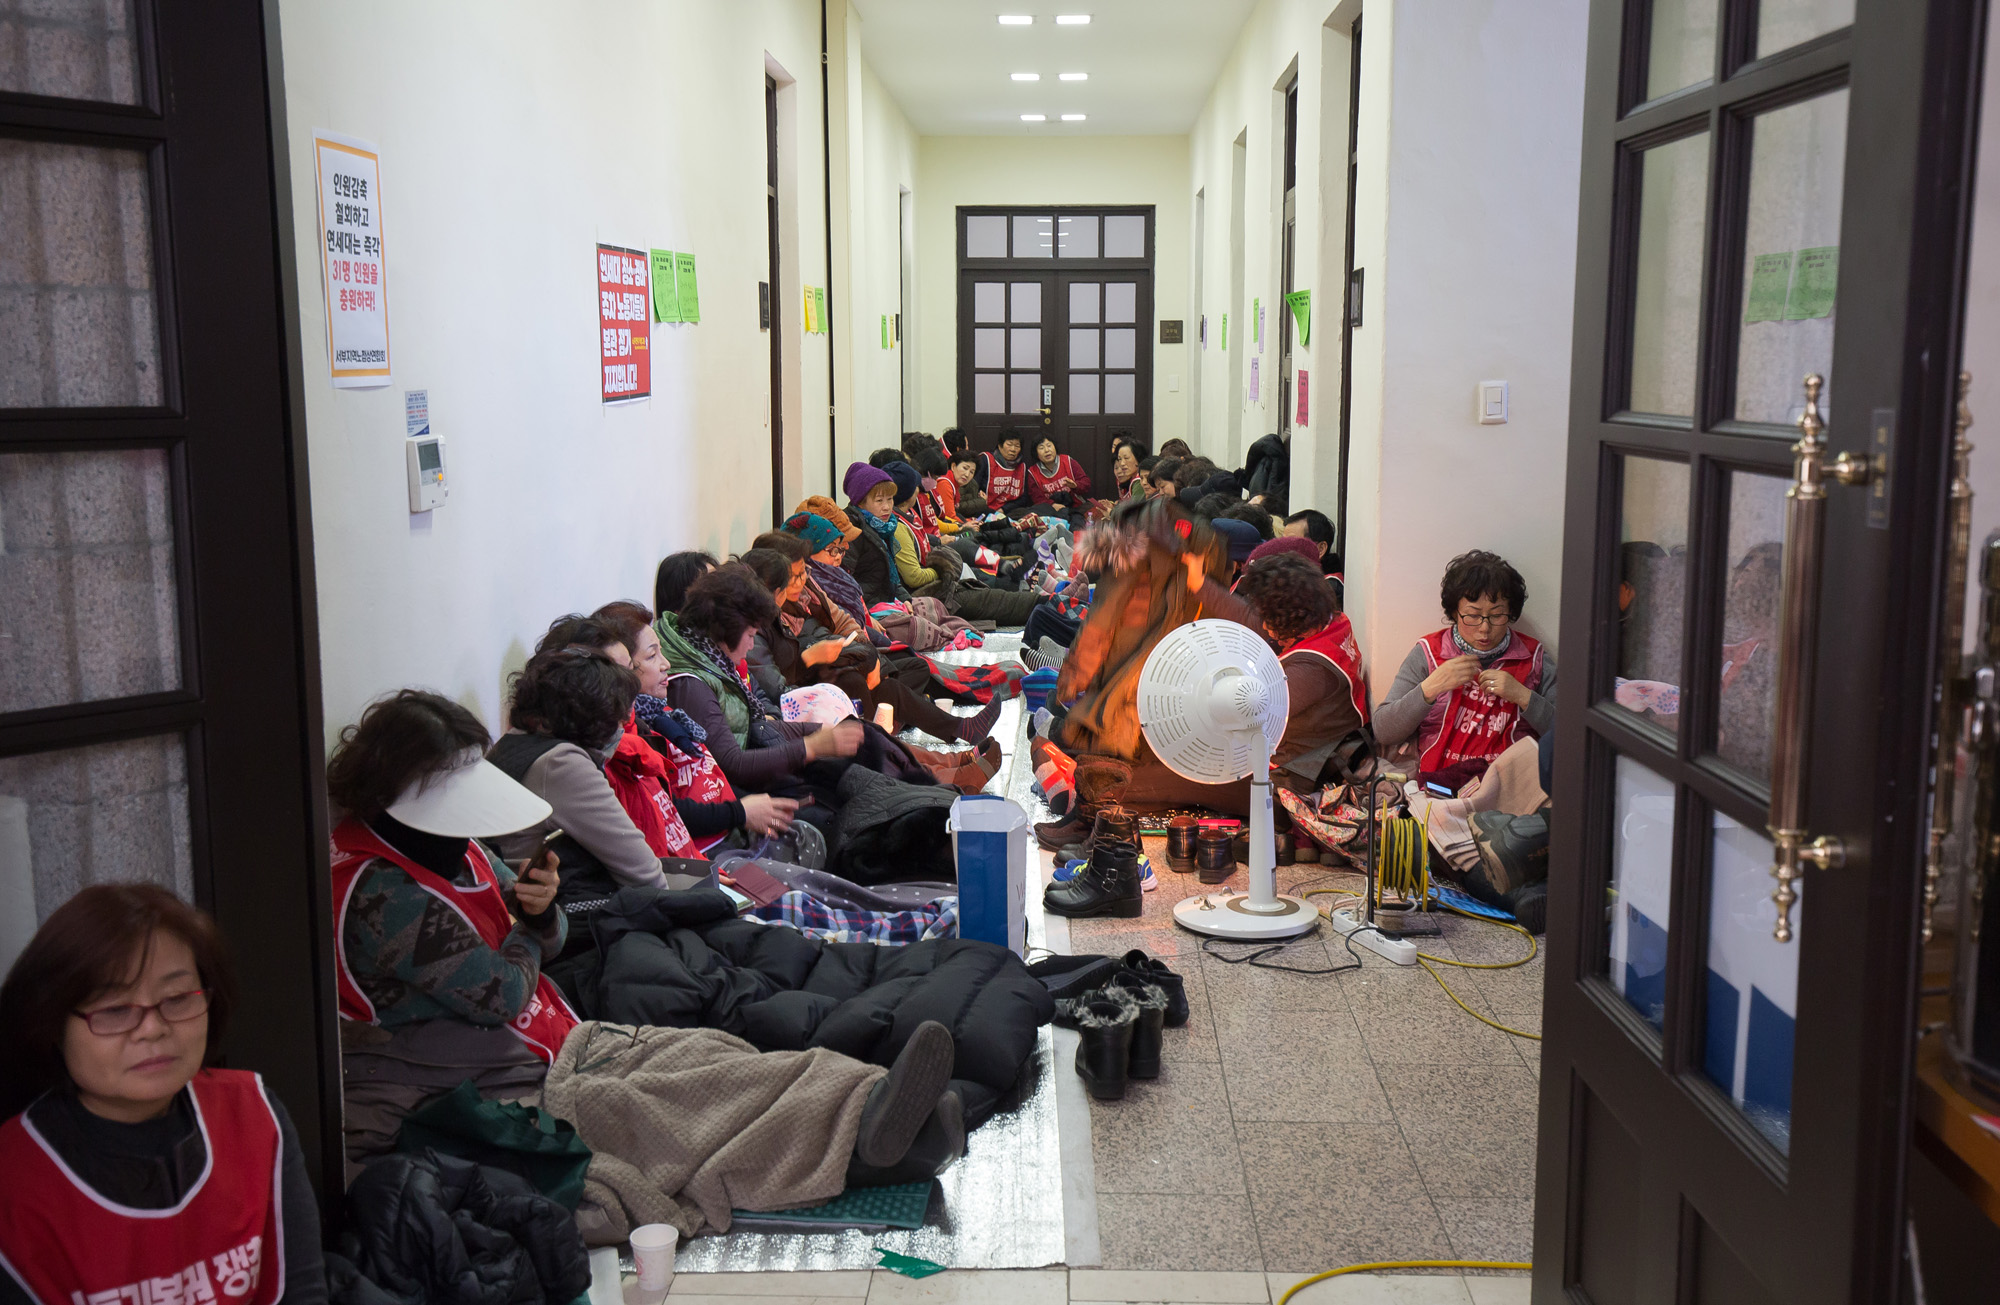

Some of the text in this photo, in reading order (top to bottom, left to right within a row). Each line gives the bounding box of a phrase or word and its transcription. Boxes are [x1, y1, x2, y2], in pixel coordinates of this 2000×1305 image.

[333, 173, 367, 201] 인원감축
[335, 202, 369, 227] 철회하고
[327, 229, 380, 258] 연세대는 즉각
[332, 259, 378, 285] 31명 인원을
[599, 253, 621, 284] 연세대
[339, 288, 376, 312] 충원하라!
[601, 291, 616, 321] 주차
[603, 328, 617, 357] 본관
